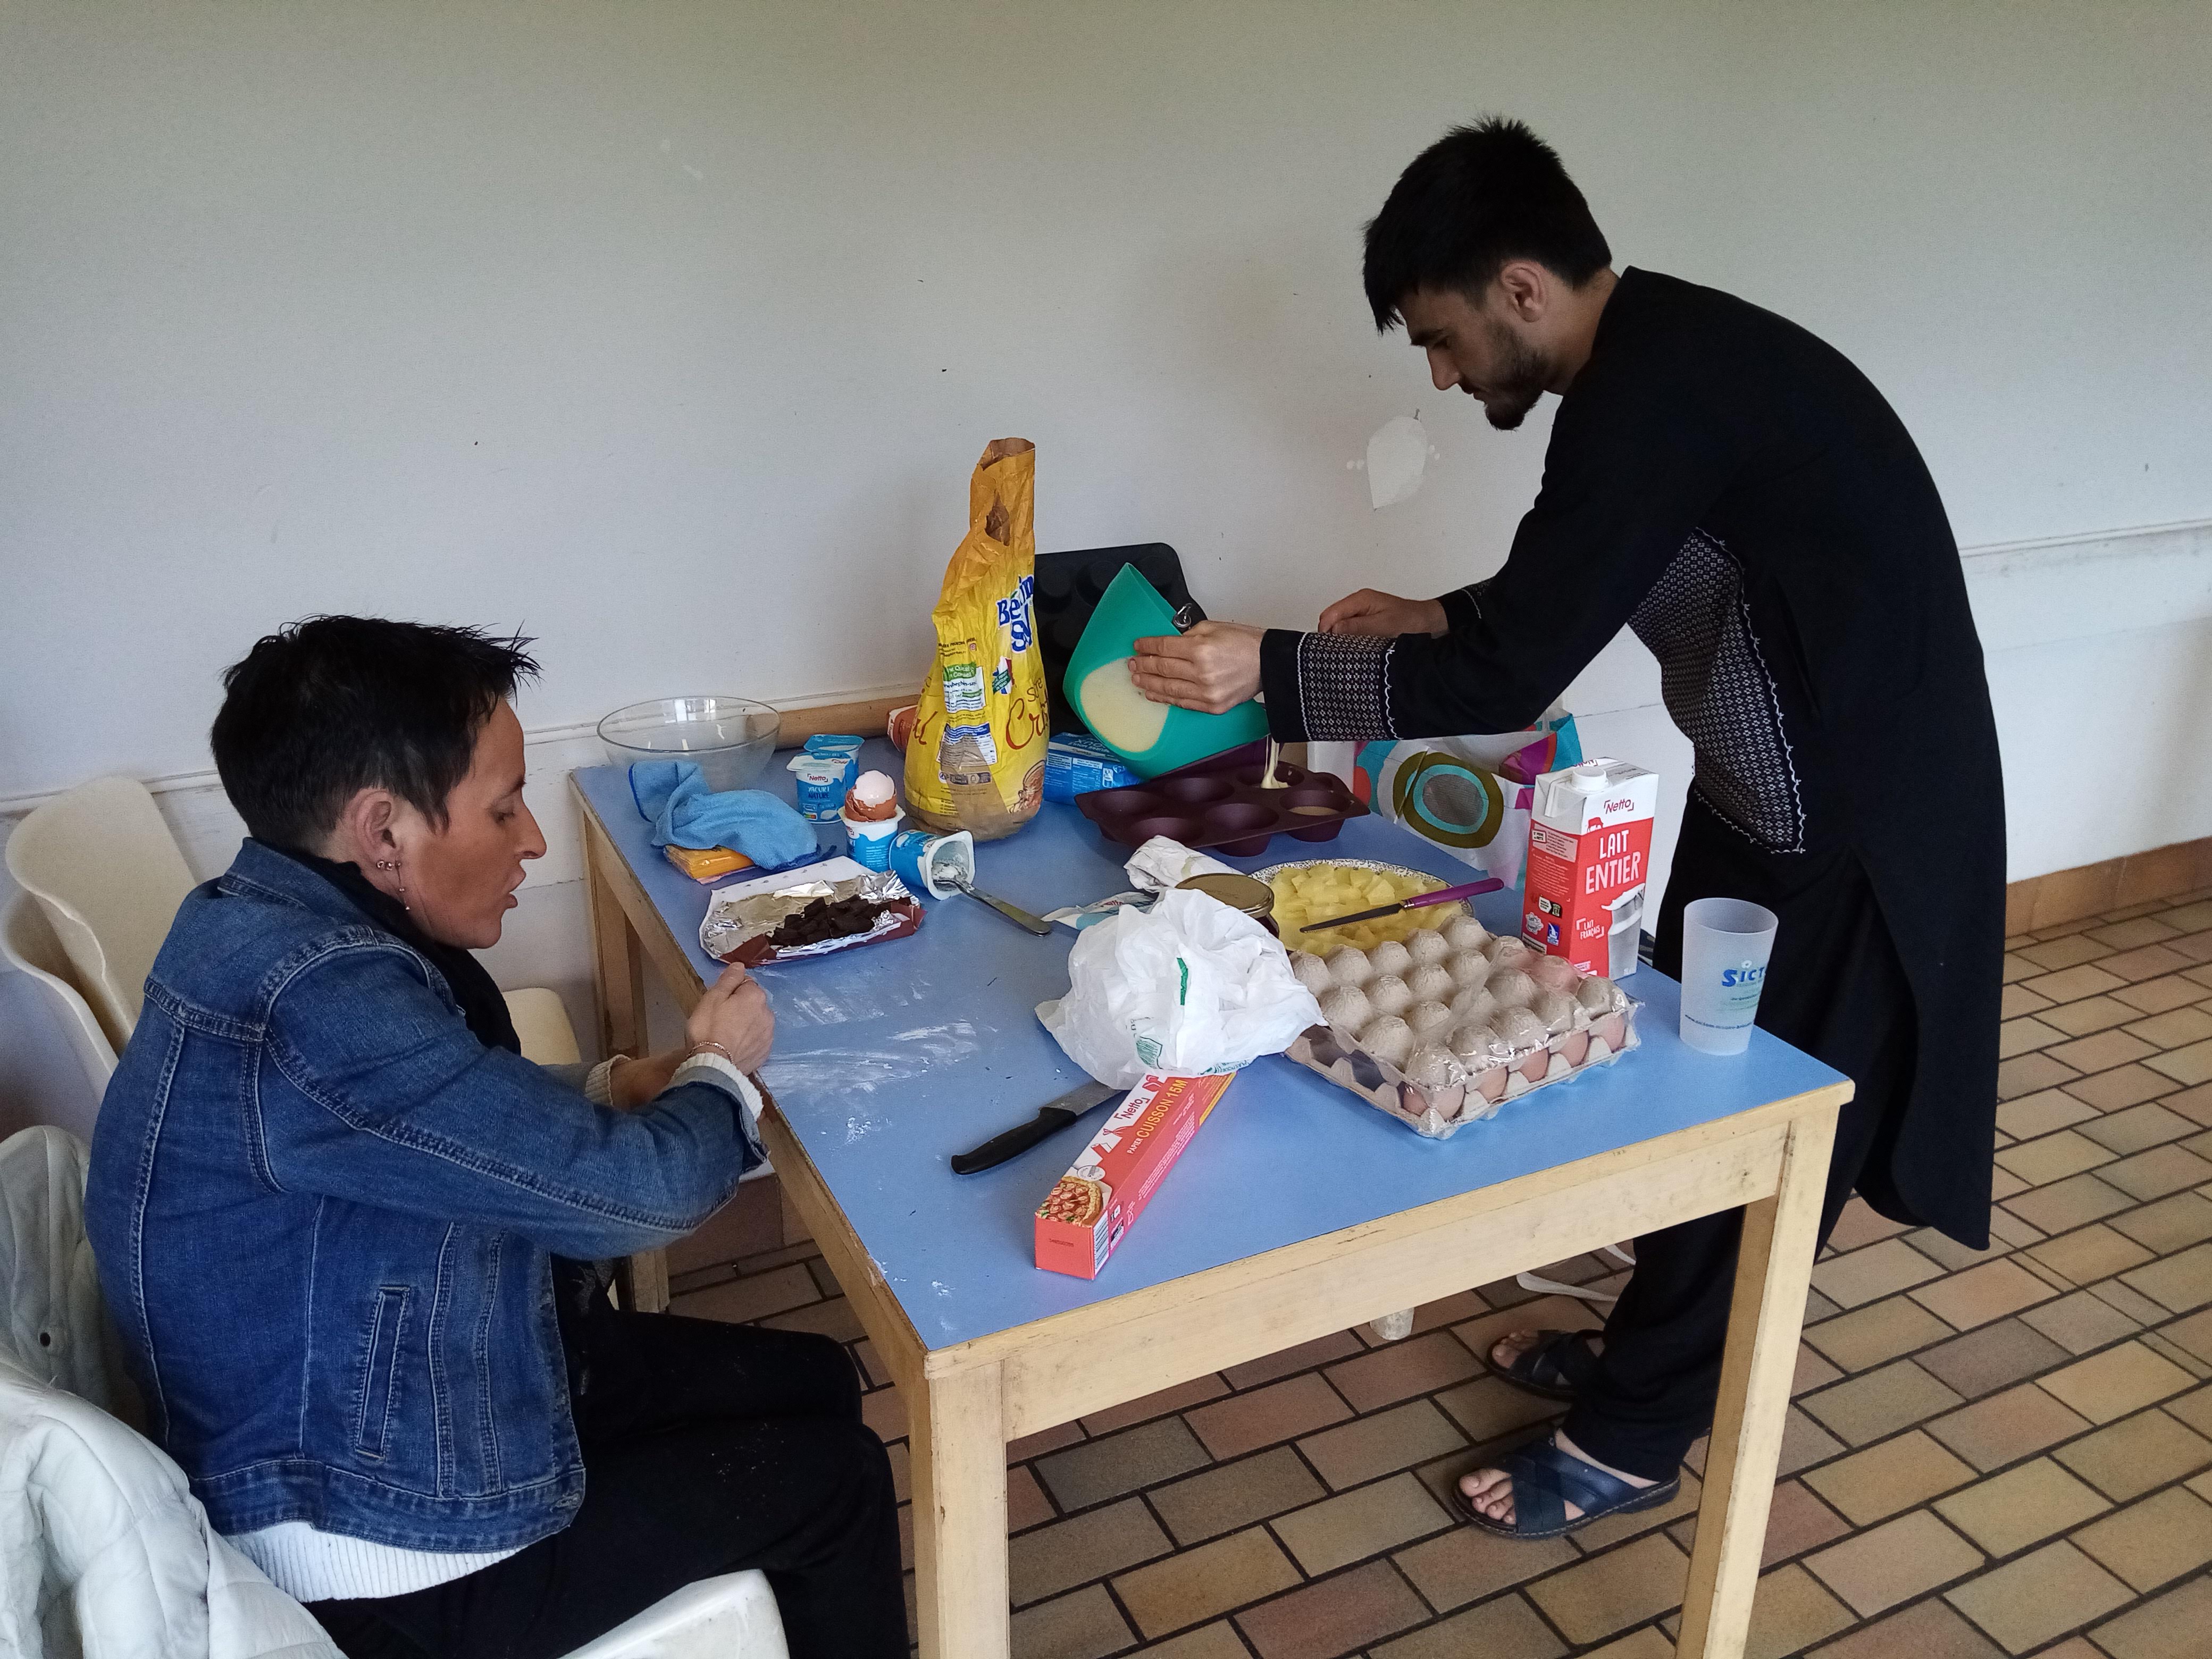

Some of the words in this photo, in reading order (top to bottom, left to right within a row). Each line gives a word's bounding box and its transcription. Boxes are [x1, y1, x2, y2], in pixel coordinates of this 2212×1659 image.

[1605, 799, 1631, 814] Netto
[1599, 830, 1629, 859] LAIT
[1585, 851, 1641, 895] ENTIER
[1584, 919, 1594, 931] LAIT
[1121, 1099, 1142, 1119] Netto
[1127, 1138, 1143, 1154] PAPIER
[1136, 1099, 1174, 1138] CUISSON
[1166, 1079, 1188, 1097] 15M
